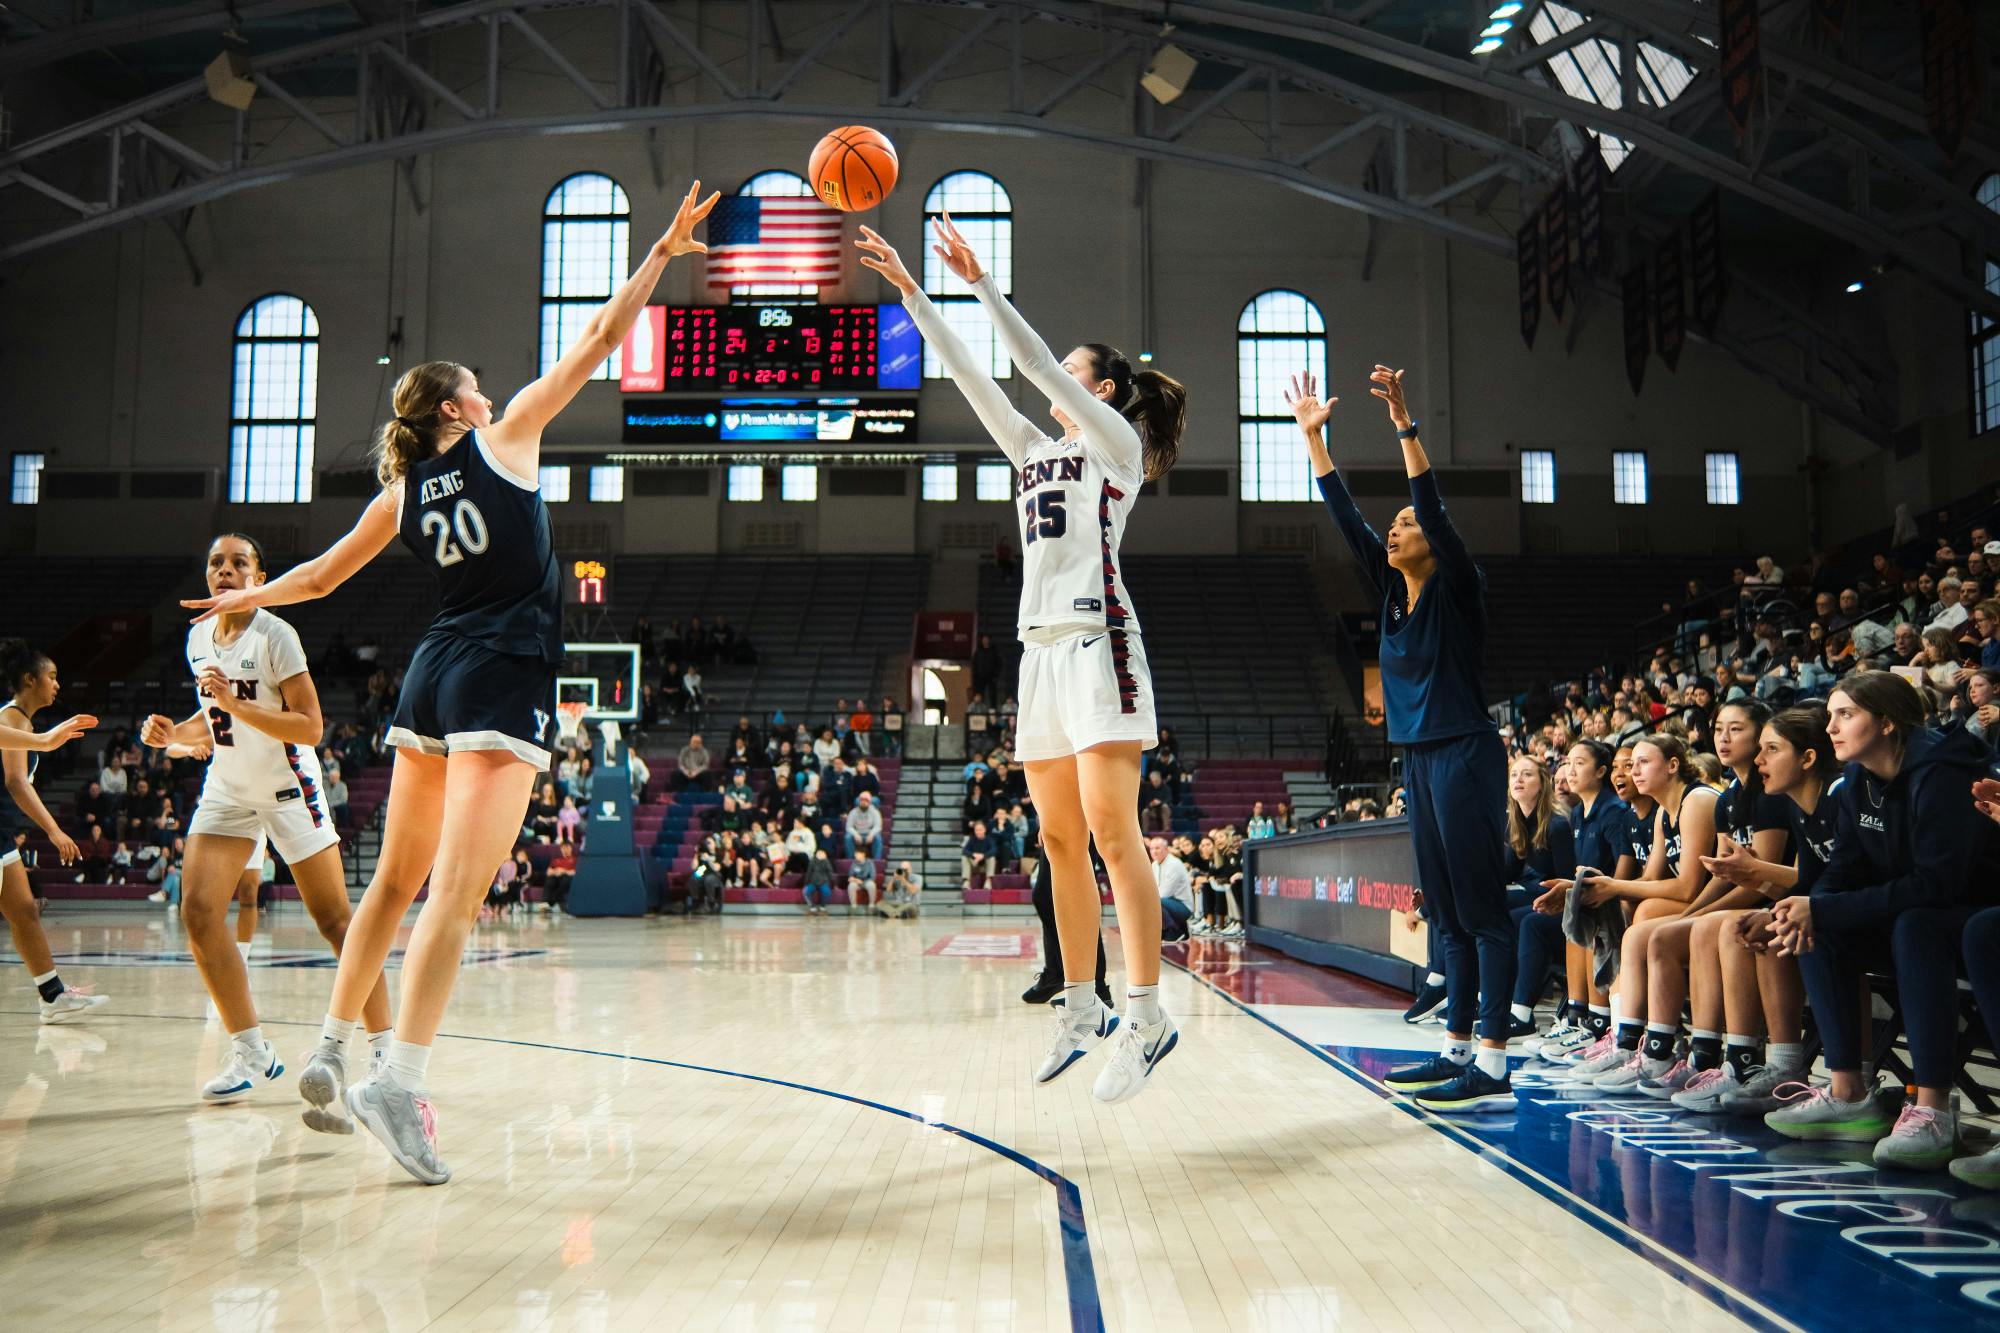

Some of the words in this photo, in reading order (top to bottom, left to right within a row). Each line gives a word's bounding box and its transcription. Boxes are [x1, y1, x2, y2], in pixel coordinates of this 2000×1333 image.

[725, 337, 748, 355] 24
[766, 339, 777, 353] 2
[805, 336, 821, 354] 13
[728, 369, 738, 383] 0
[811, 369, 822, 383] 0
[1026, 490, 1067, 547] 25
[421, 498, 490, 568] 20
[580, 577, 602, 603] 17
[209, 706, 235, 747] 2
[534, 707, 550, 743] Y
[1373, 881, 1392, 910] ZERO
[1393, 883, 1415, 912] SUGA
